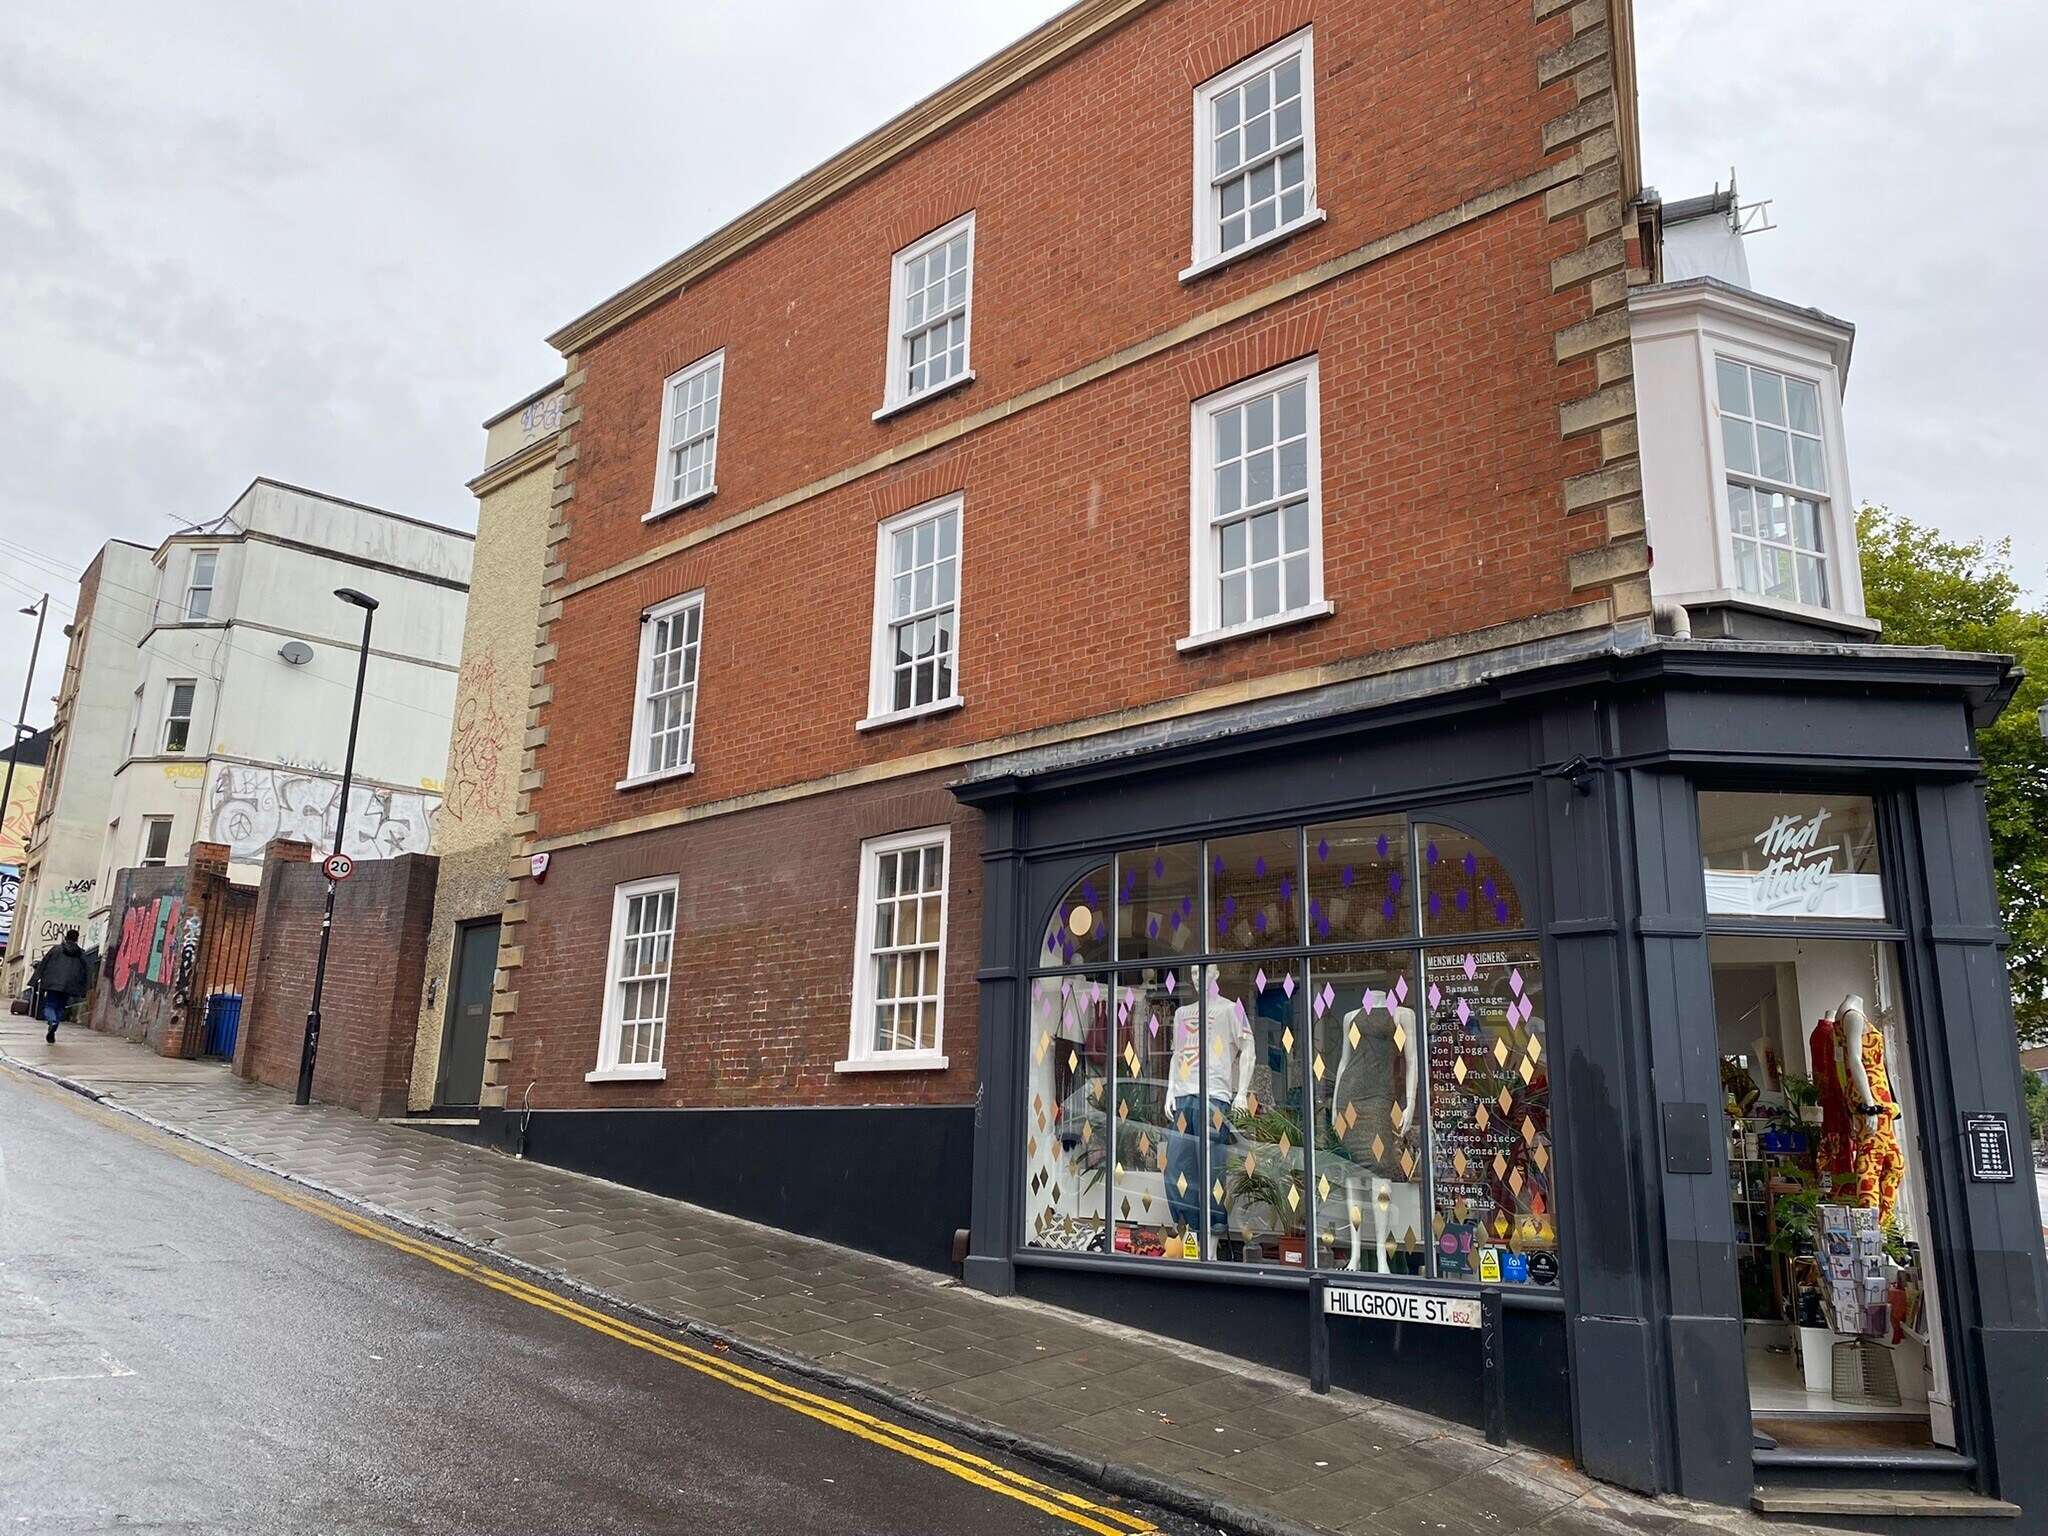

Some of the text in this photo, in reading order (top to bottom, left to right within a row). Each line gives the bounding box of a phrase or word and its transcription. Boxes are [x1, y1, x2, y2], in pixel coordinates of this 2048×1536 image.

[1754, 807, 1832, 857] that
[330, 860, 350, 873] 20
[1751, 848, 1840, 912] thing
[1427, 951, 1508, 967] MENSWEAR SIGNERS:
[1428, 971, 1490, 982] Horizon Bay
[1445, 985, 1479, 994] Banana
[1430, 1007, 1504, 1018] Far Fm Home
[1429, 1022, 1460, 1031] Conch
[1431, 1033, 1477, 1044] Long Fox
[1432, 1045, 1489, 1056] Joe Bloggs
[1432, 1059, 1455, 1067] Mute
[1432, 1070, 1517, 1080] Wher The Wall
[1433, 1083, 1456, 1092] Sulk
[1433, 1095, 1497, 1106] Jungle Funk
[1434, 1108, 1469, 1119] Sprung
[1434, 1121, 1491, 1130] Who Care?
[1435, 1133, 1517, 1143] Alfresco Disco
[1436, 1146, 1511, 1156] Lady Gonzalez
[1437, 1185, 1483, 1196] Wavegang
[1330, 1291, 1470, 1324] HILLGROVE ST. BS2
